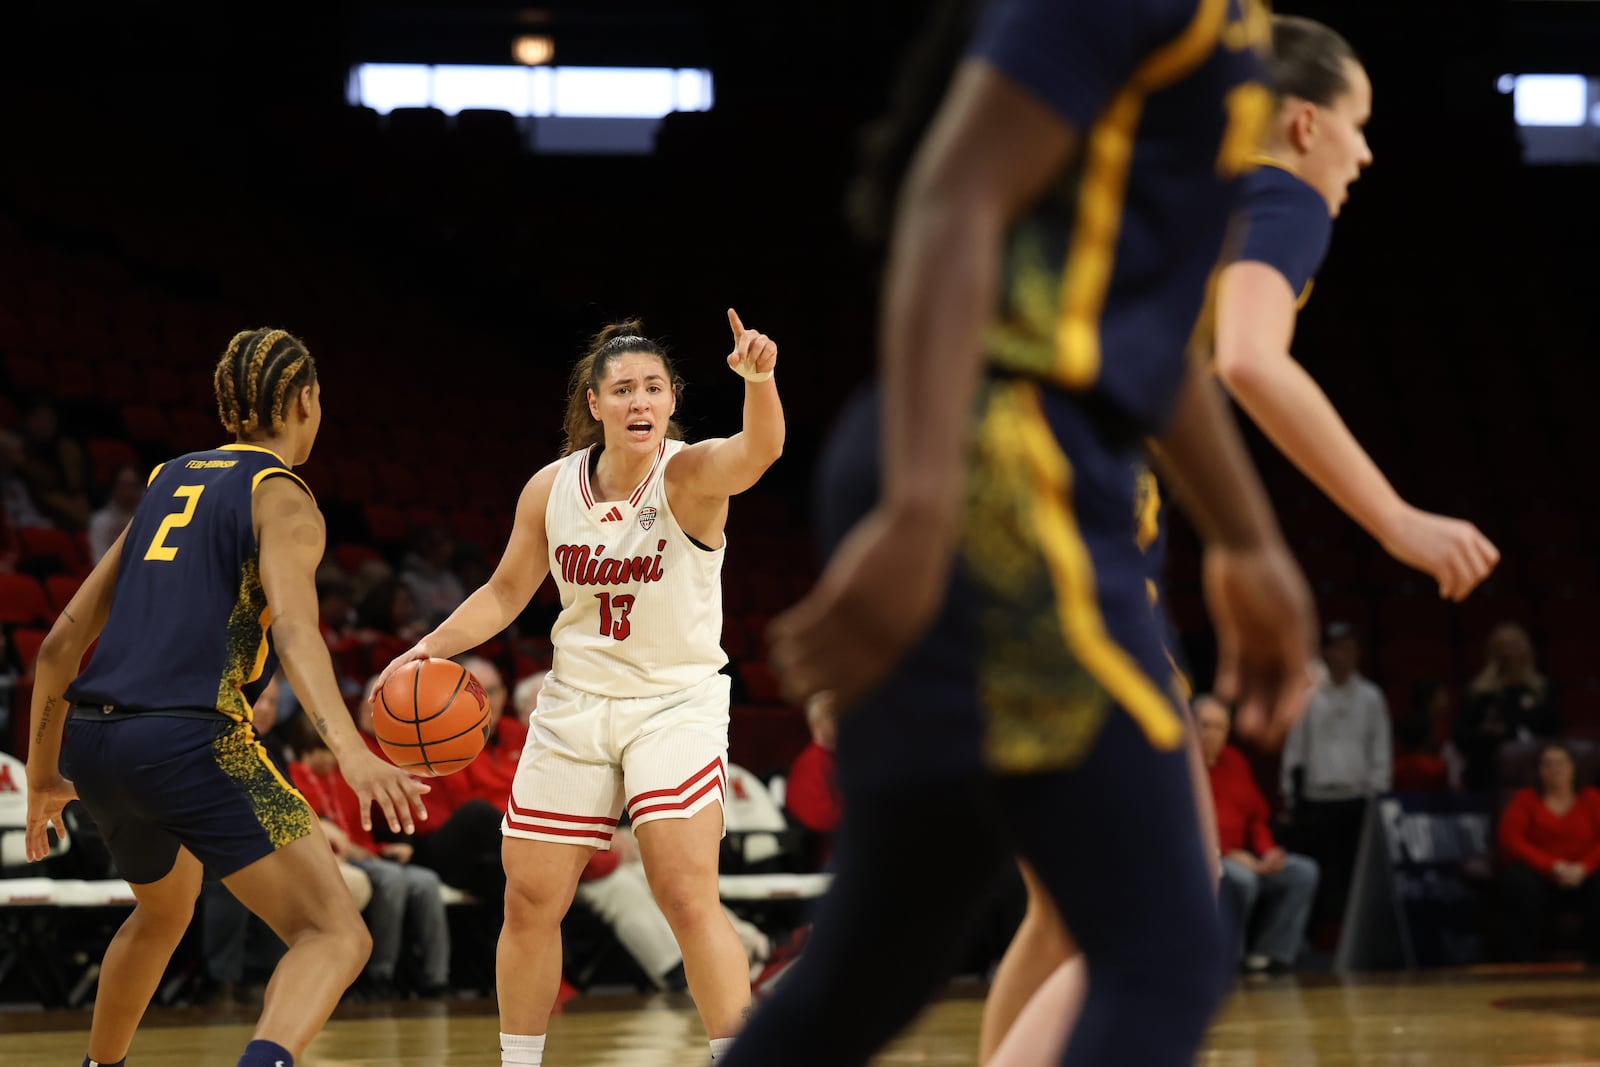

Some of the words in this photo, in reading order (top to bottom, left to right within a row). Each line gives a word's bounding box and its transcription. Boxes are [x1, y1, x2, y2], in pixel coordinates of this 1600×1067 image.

[143, 484, 206, 561] 2
[555, 539, 667, 586] Miami
[594, 592, 636, 641] 13
